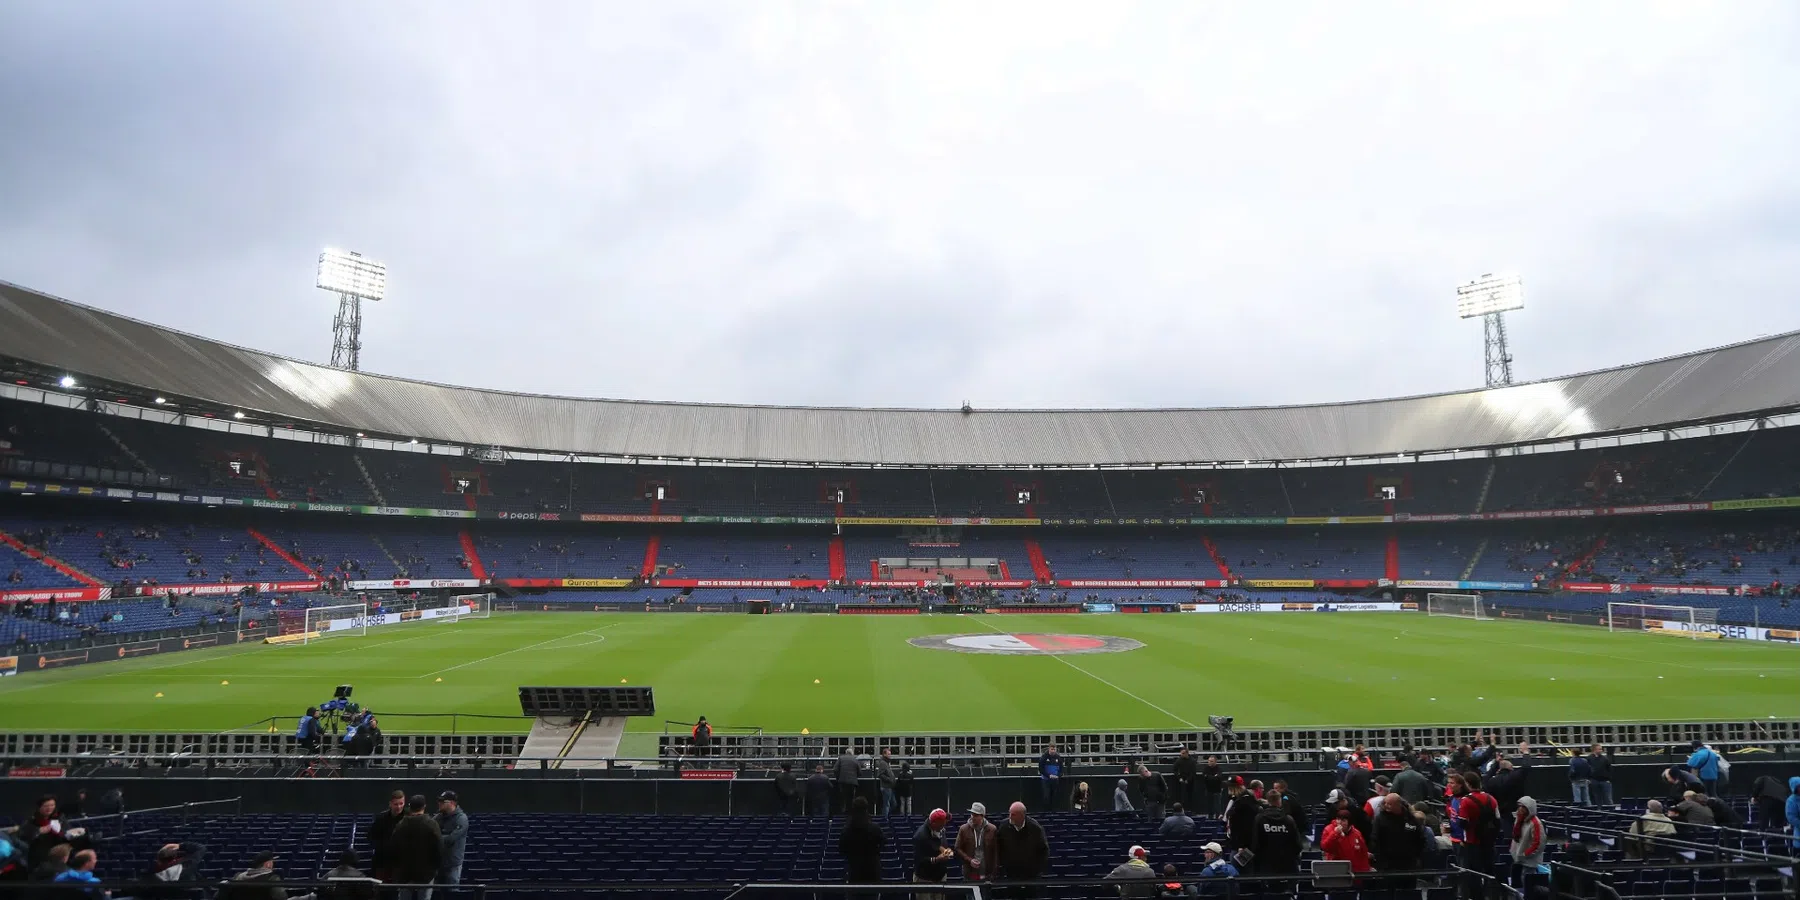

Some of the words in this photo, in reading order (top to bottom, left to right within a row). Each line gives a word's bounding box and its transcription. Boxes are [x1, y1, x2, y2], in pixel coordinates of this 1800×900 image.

[253, 500, 289, 509] Heineken
[308, 503, 344, 512] Heineken
[510, 512, 537, 520] pepsi
[1219, 604, 1261, 612] DACHSER
[1263, 823, 1289, 833] Bart.
